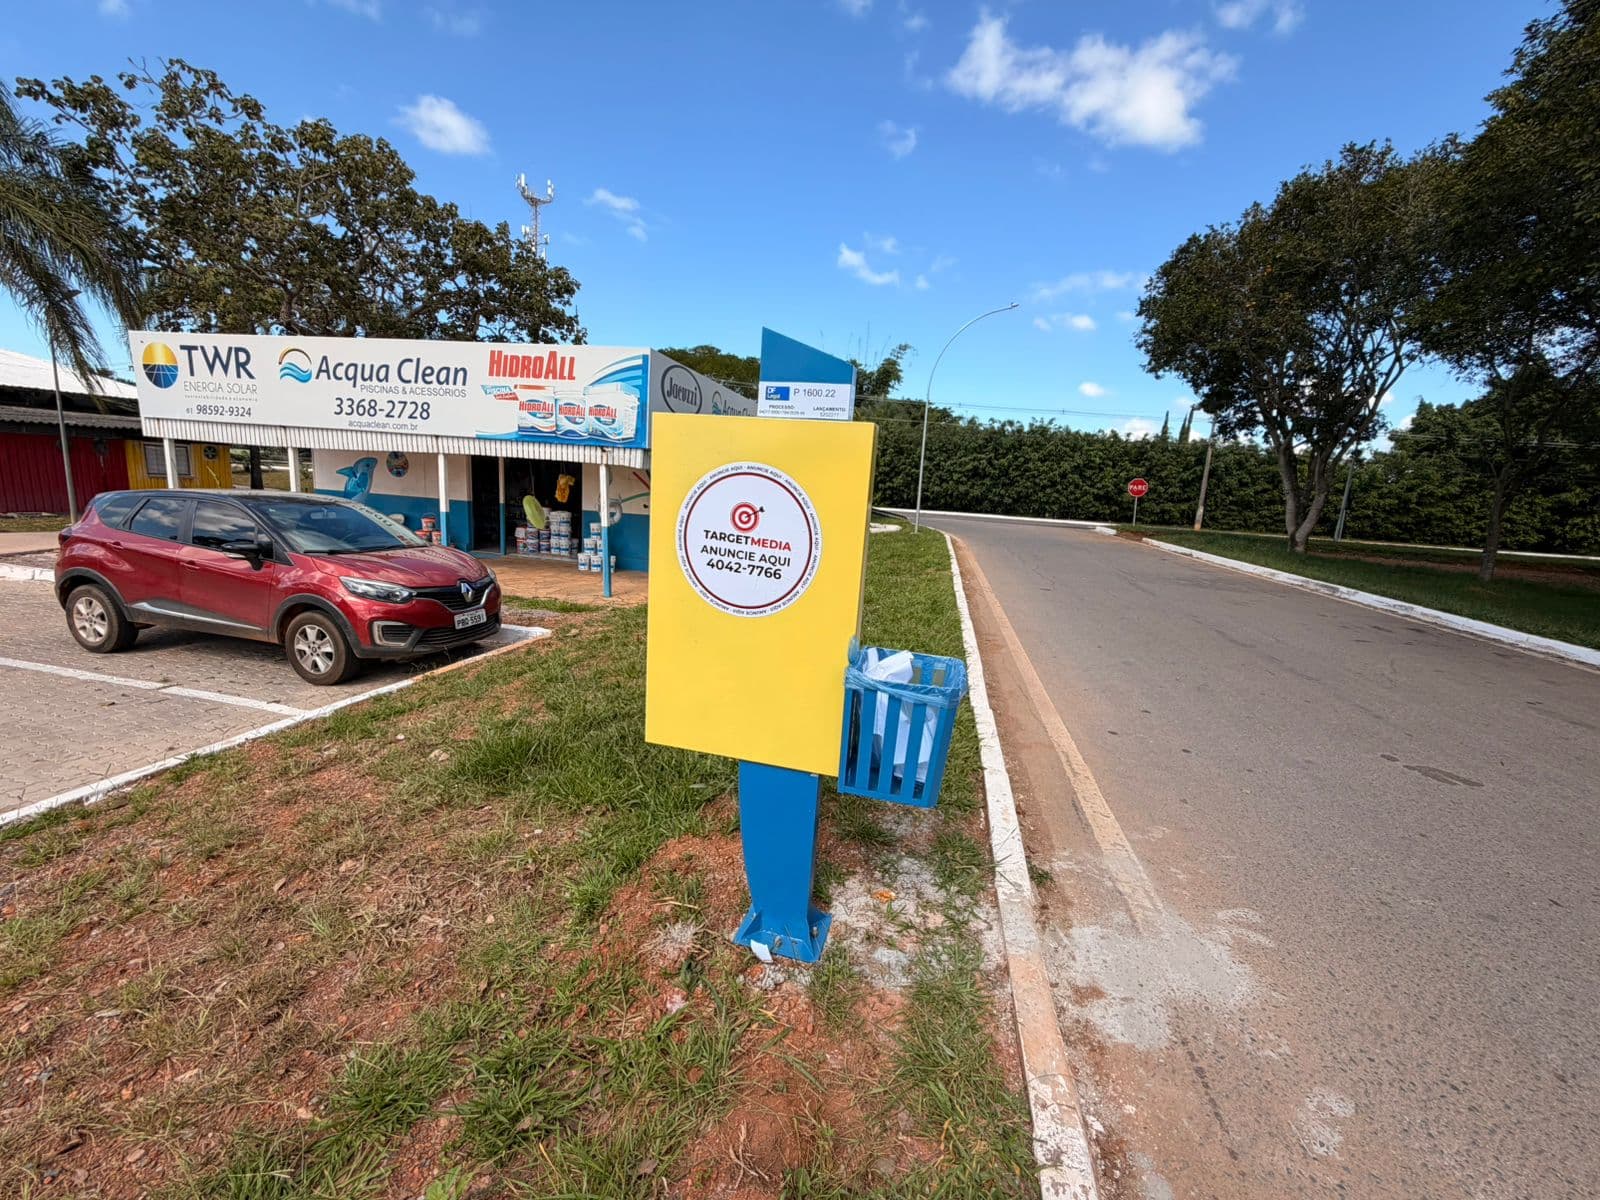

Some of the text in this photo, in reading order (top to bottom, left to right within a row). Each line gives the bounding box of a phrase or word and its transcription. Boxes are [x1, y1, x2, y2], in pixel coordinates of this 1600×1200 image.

[179, 344, 256, 379] TWR
[315, 355, 468, 388] Acqua Clean
[183, 380, 258, 395] ENERGIA SOLAR
[360, 384, 467, 398] PISCINAS & ACESSÓRIOS
[793, 388, 836, 398] P 1600.22
[196, 404, 252, 417] 98592-9324
[334, 397, 431, 420] 3368-2728
[348, 420, 418, 431] acquaclean.com.br
[703, 529, 792, 552] TARGETMEDIA
[700, 545, 791, 567] ANUNCIE AQUI
[706, 558, 782, 580] 4042-7766
